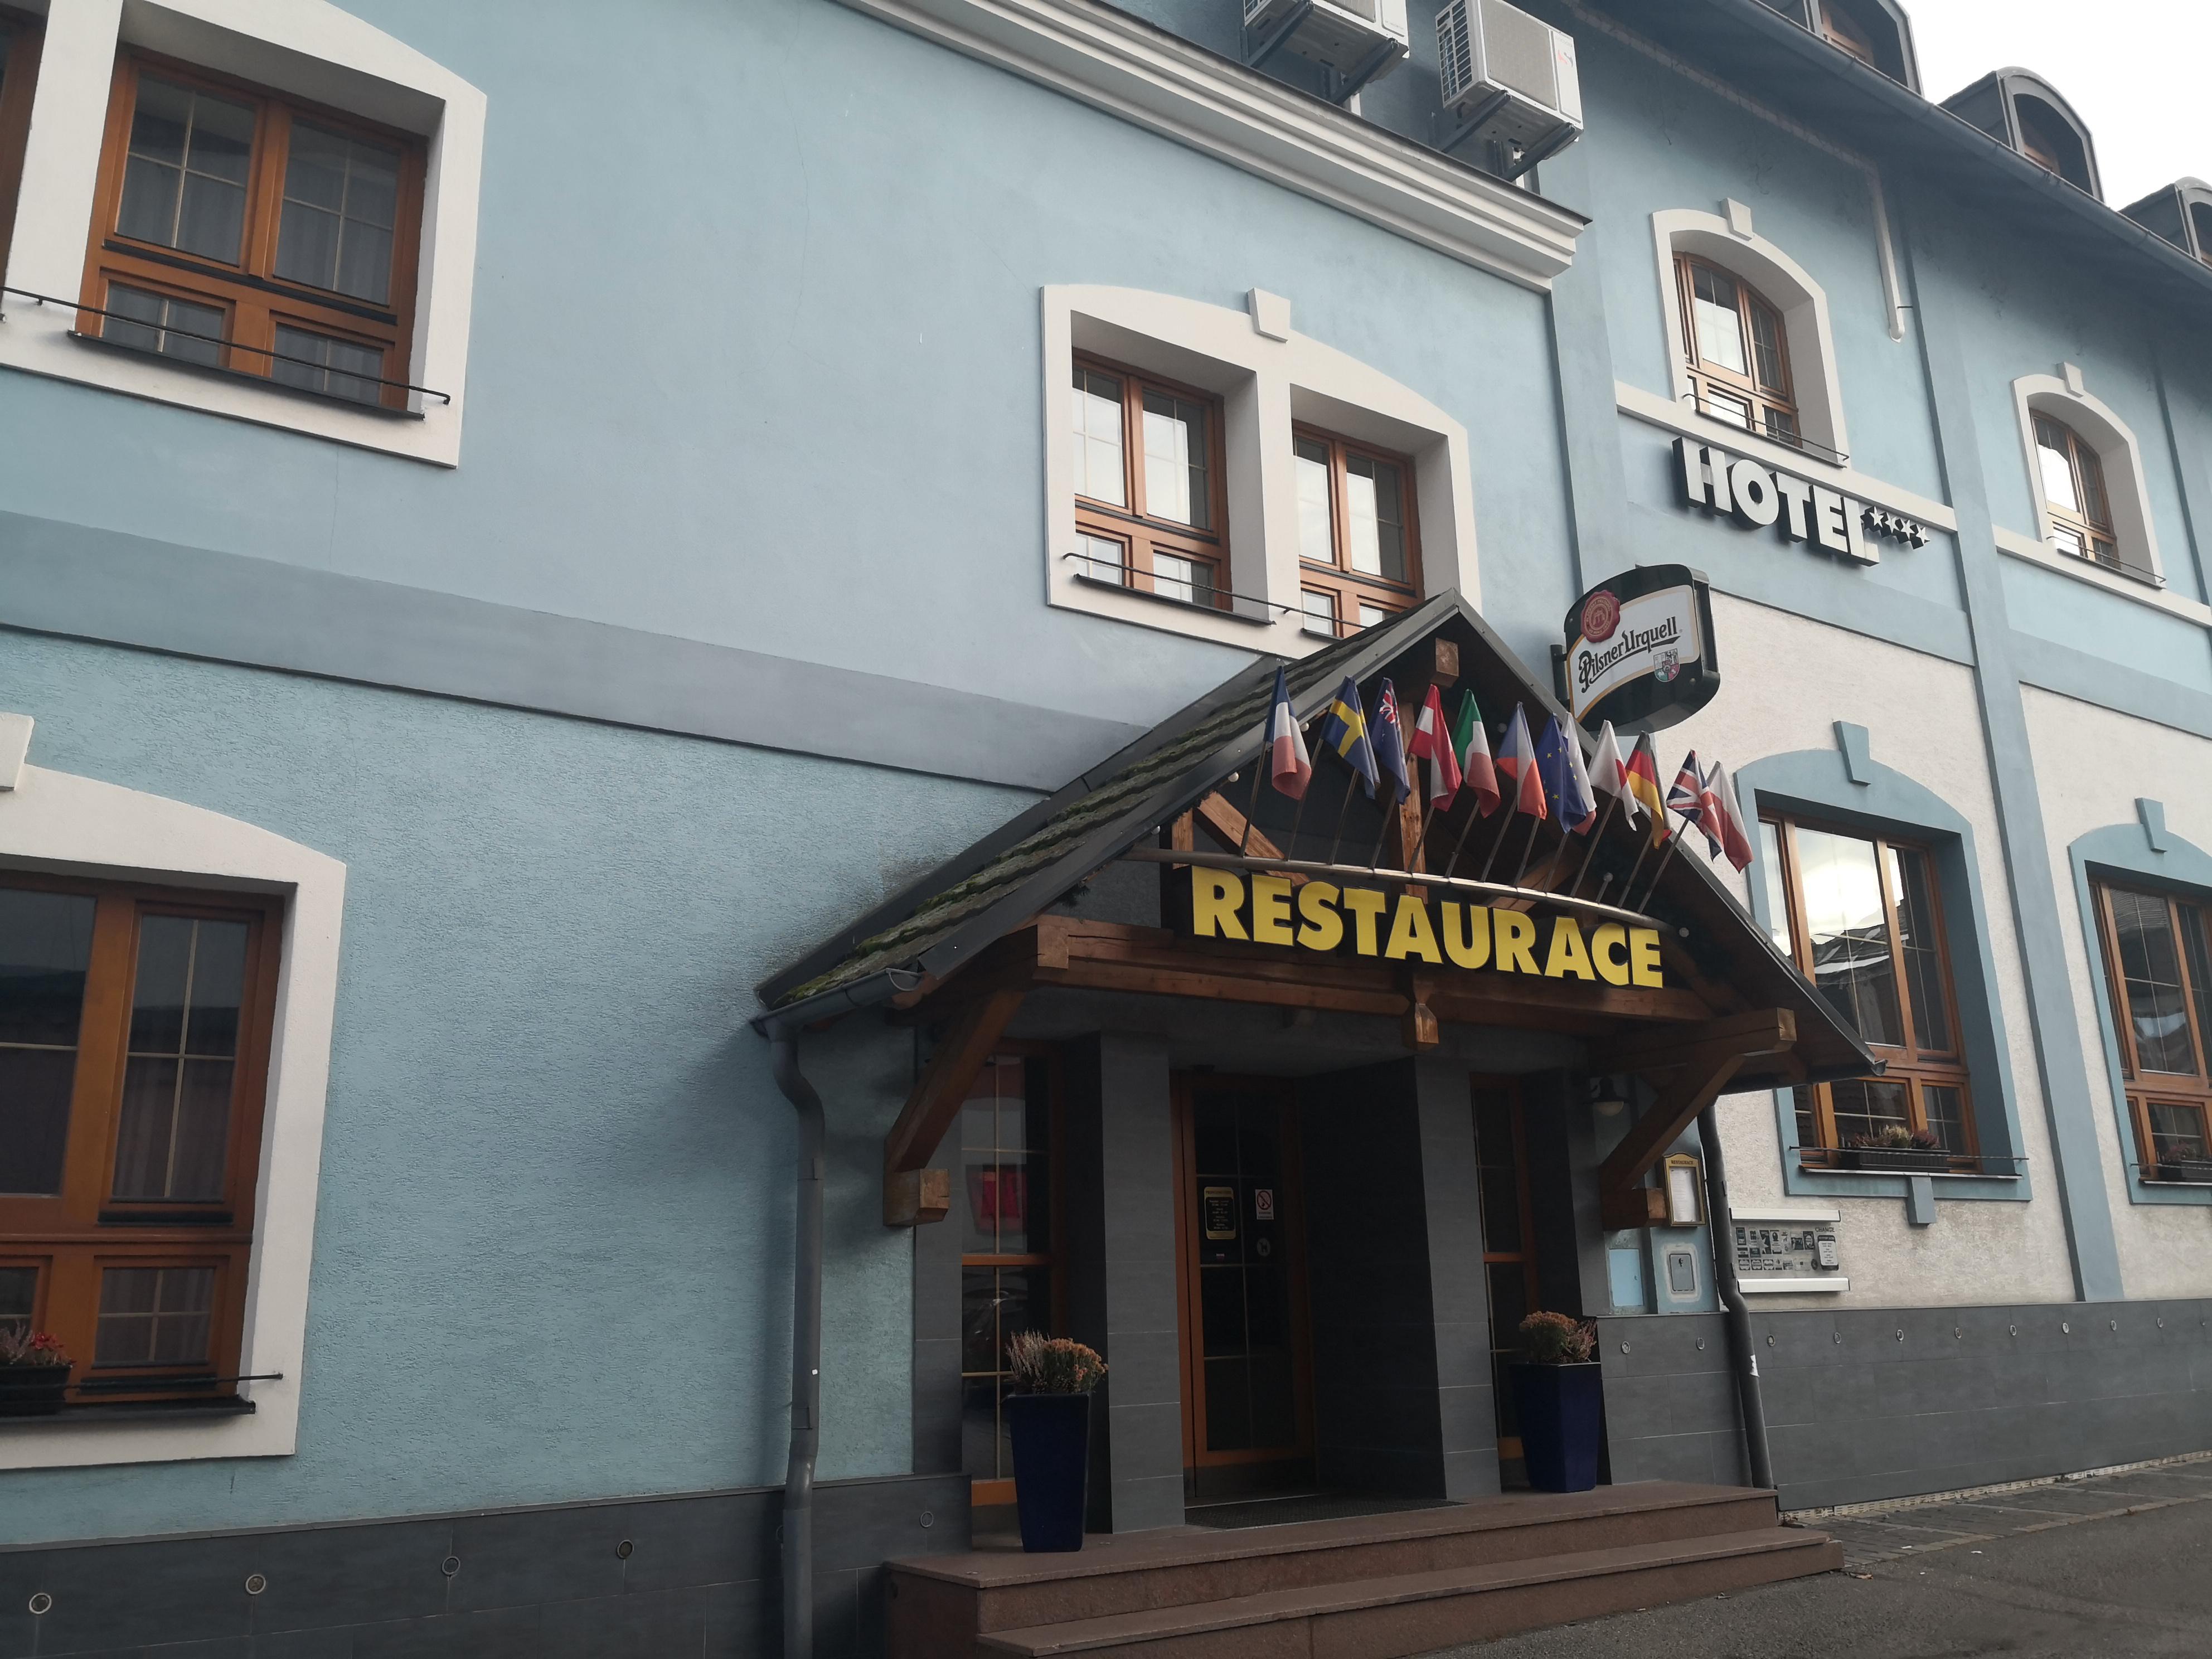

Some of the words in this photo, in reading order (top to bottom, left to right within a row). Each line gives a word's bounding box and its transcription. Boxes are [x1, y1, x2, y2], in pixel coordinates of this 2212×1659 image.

[1673, 436, 1879, 565] HOTEL
[1579, 642, 1624, 693] Pilsner
[1622, 617, 1677, 653] Urquell
[1191, 866, 1663, 988] RESTAURACE
